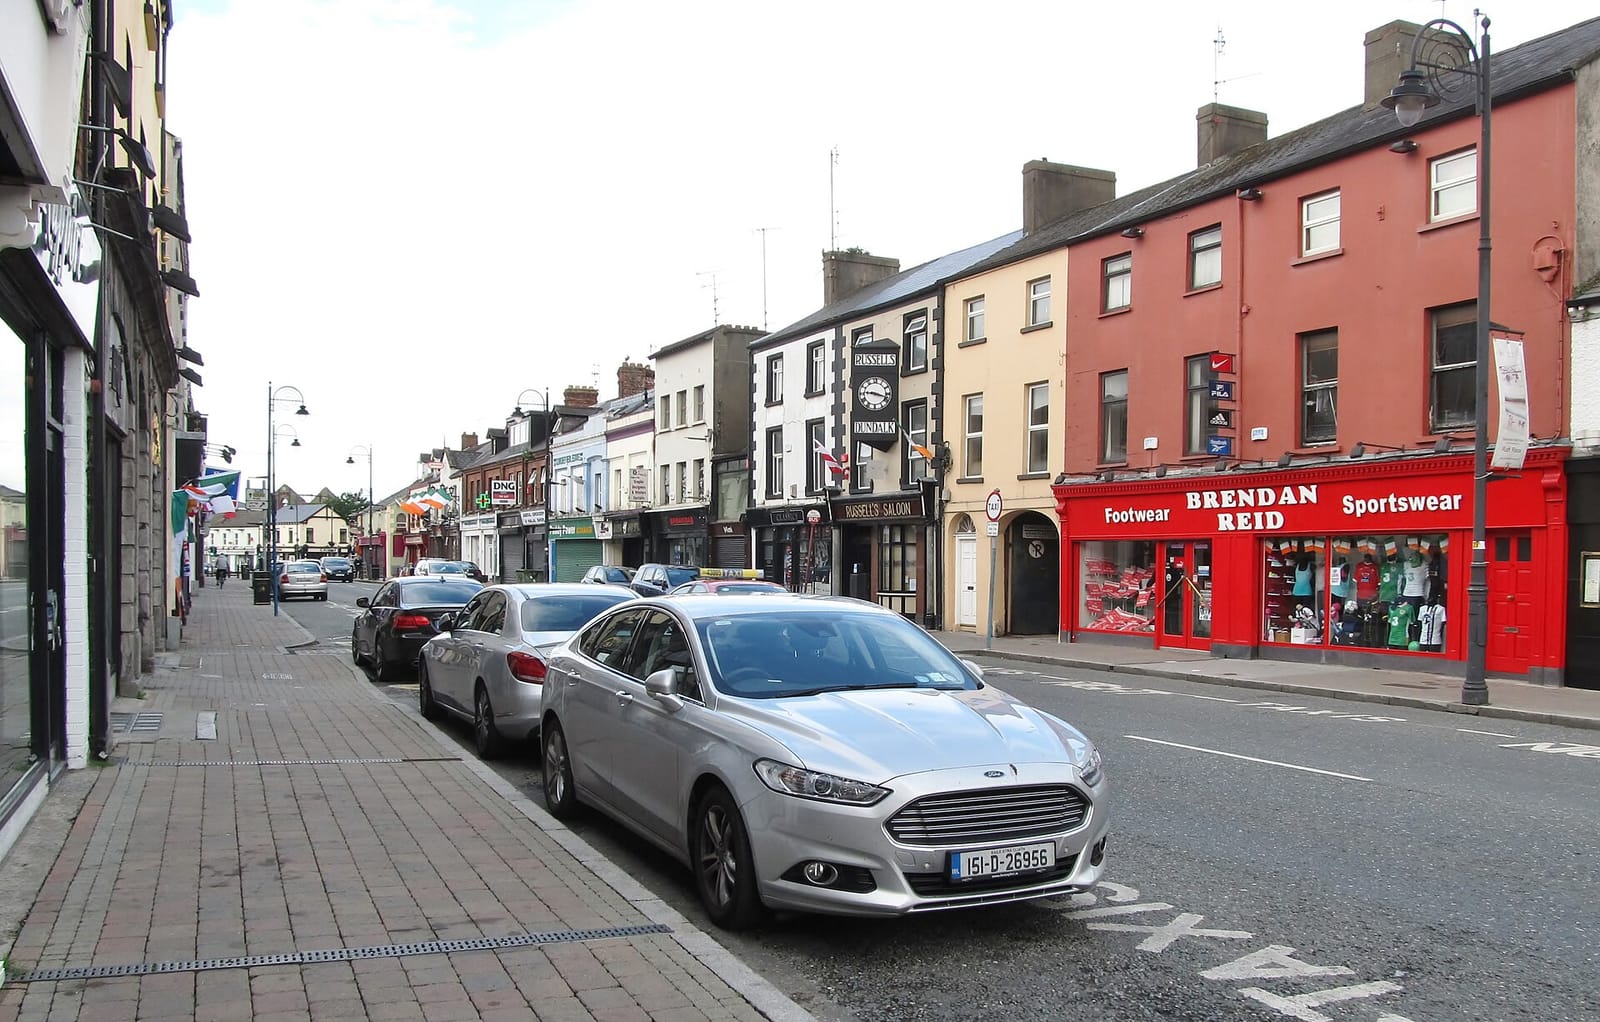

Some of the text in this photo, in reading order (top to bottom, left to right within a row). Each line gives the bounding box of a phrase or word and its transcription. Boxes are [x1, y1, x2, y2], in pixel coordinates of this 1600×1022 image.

[854, 421, 896, 433] DUNDALK
[493, 482, 515, 490] DNG
[1186, 484, 1318, 510] BRENDAN
[1342, 492, 1463, 518] Sportswear
[845, 501, 912, 518] RUSSELL'S SALOON
[1104, 507, 1170, 524] Footwear
[1217, 511, 1285, 531] REID
[723, 568, 743, 577] TAXI
[1382, 573, 1390, 583] 3
[1391, 616, 1399, 626] 3
[967, 849, 1048, 876] 151-D-26956
